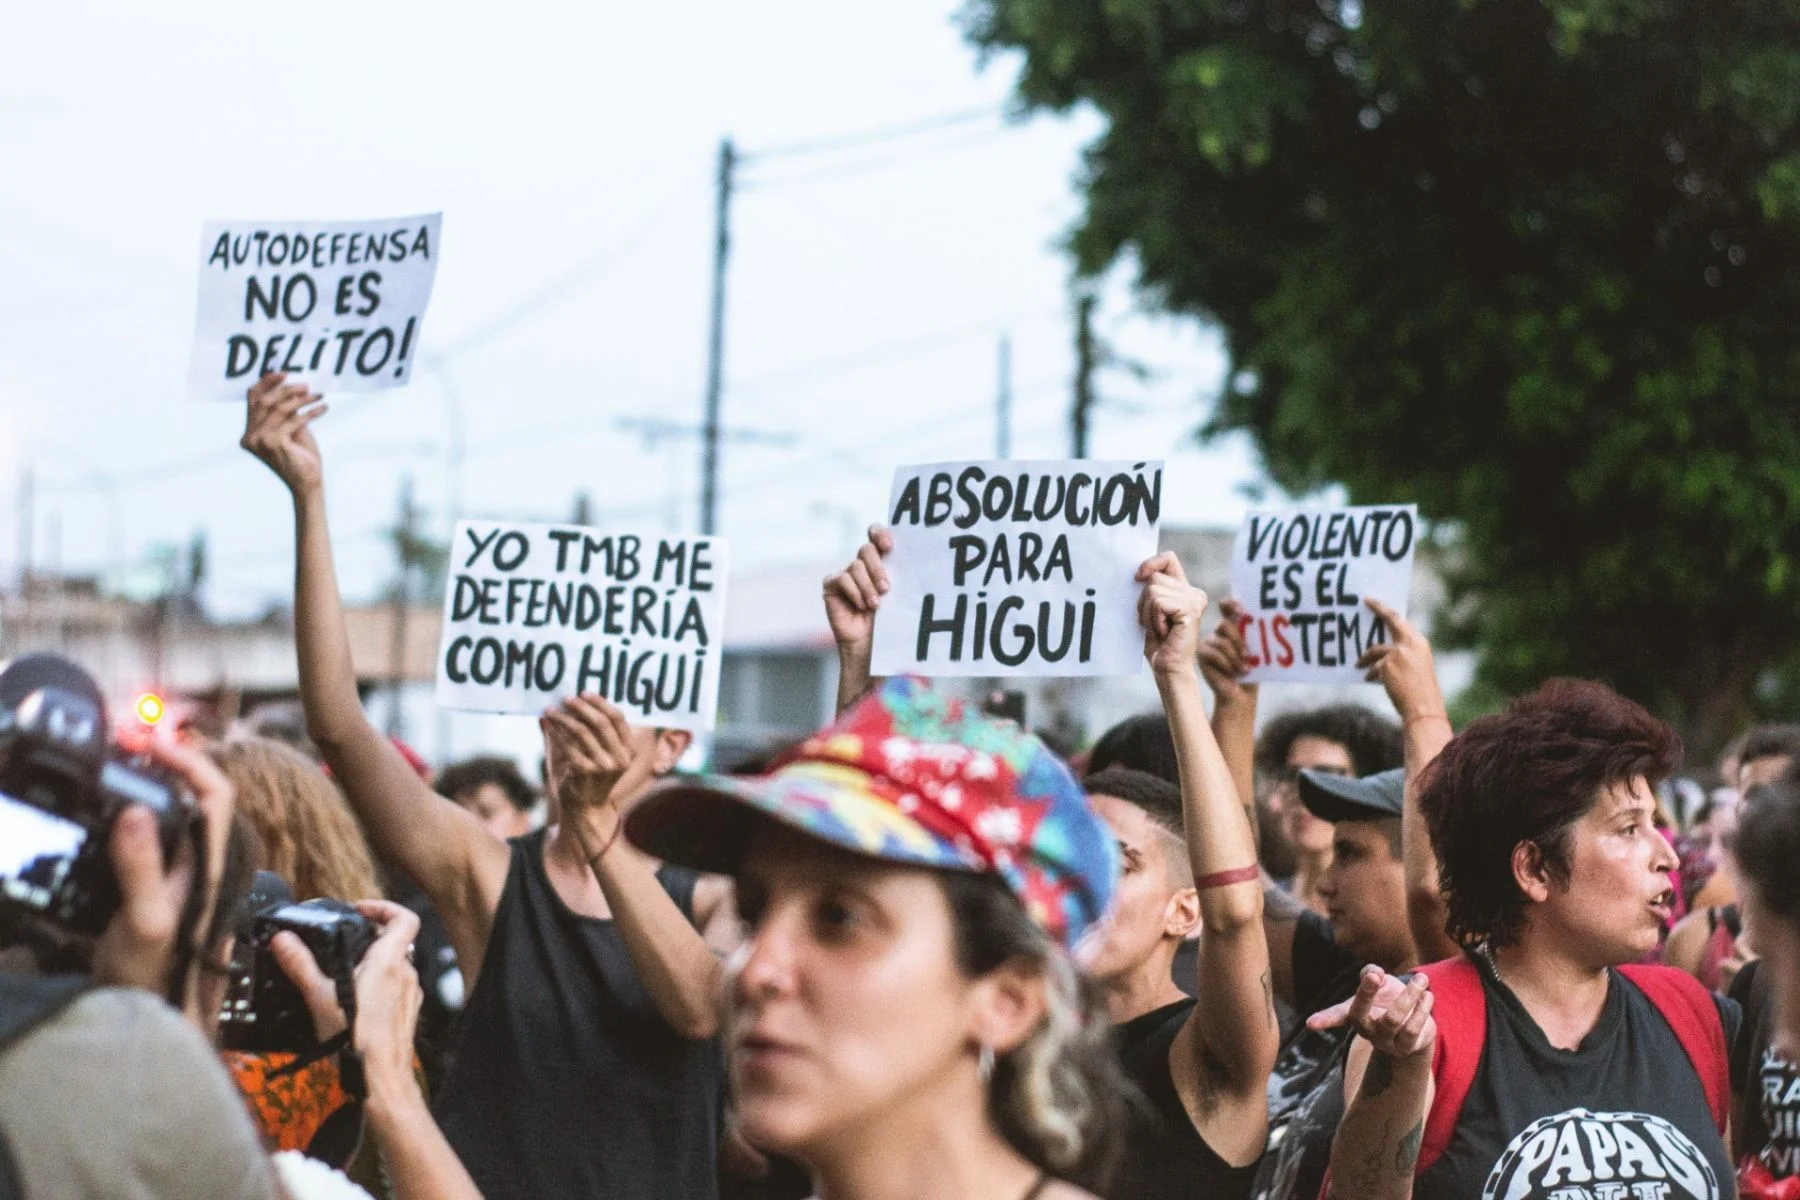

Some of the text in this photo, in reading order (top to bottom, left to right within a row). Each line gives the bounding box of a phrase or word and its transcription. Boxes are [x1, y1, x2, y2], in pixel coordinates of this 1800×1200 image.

[209, 225, 430, 271] AUTODEFENSA
[245, 270, 382, 322] NO ES
[891, 462, 1162, 529] ABSOLUCIÓN
[465, 528, 713, 592] YO TMB ME
[948, 531, 1073, 586] PARA
[1247, 510, 1414, 562] VIOLENTO
[1260, 562, 1359, 610] ES EL
[446, 635, 566, 692] COMO
